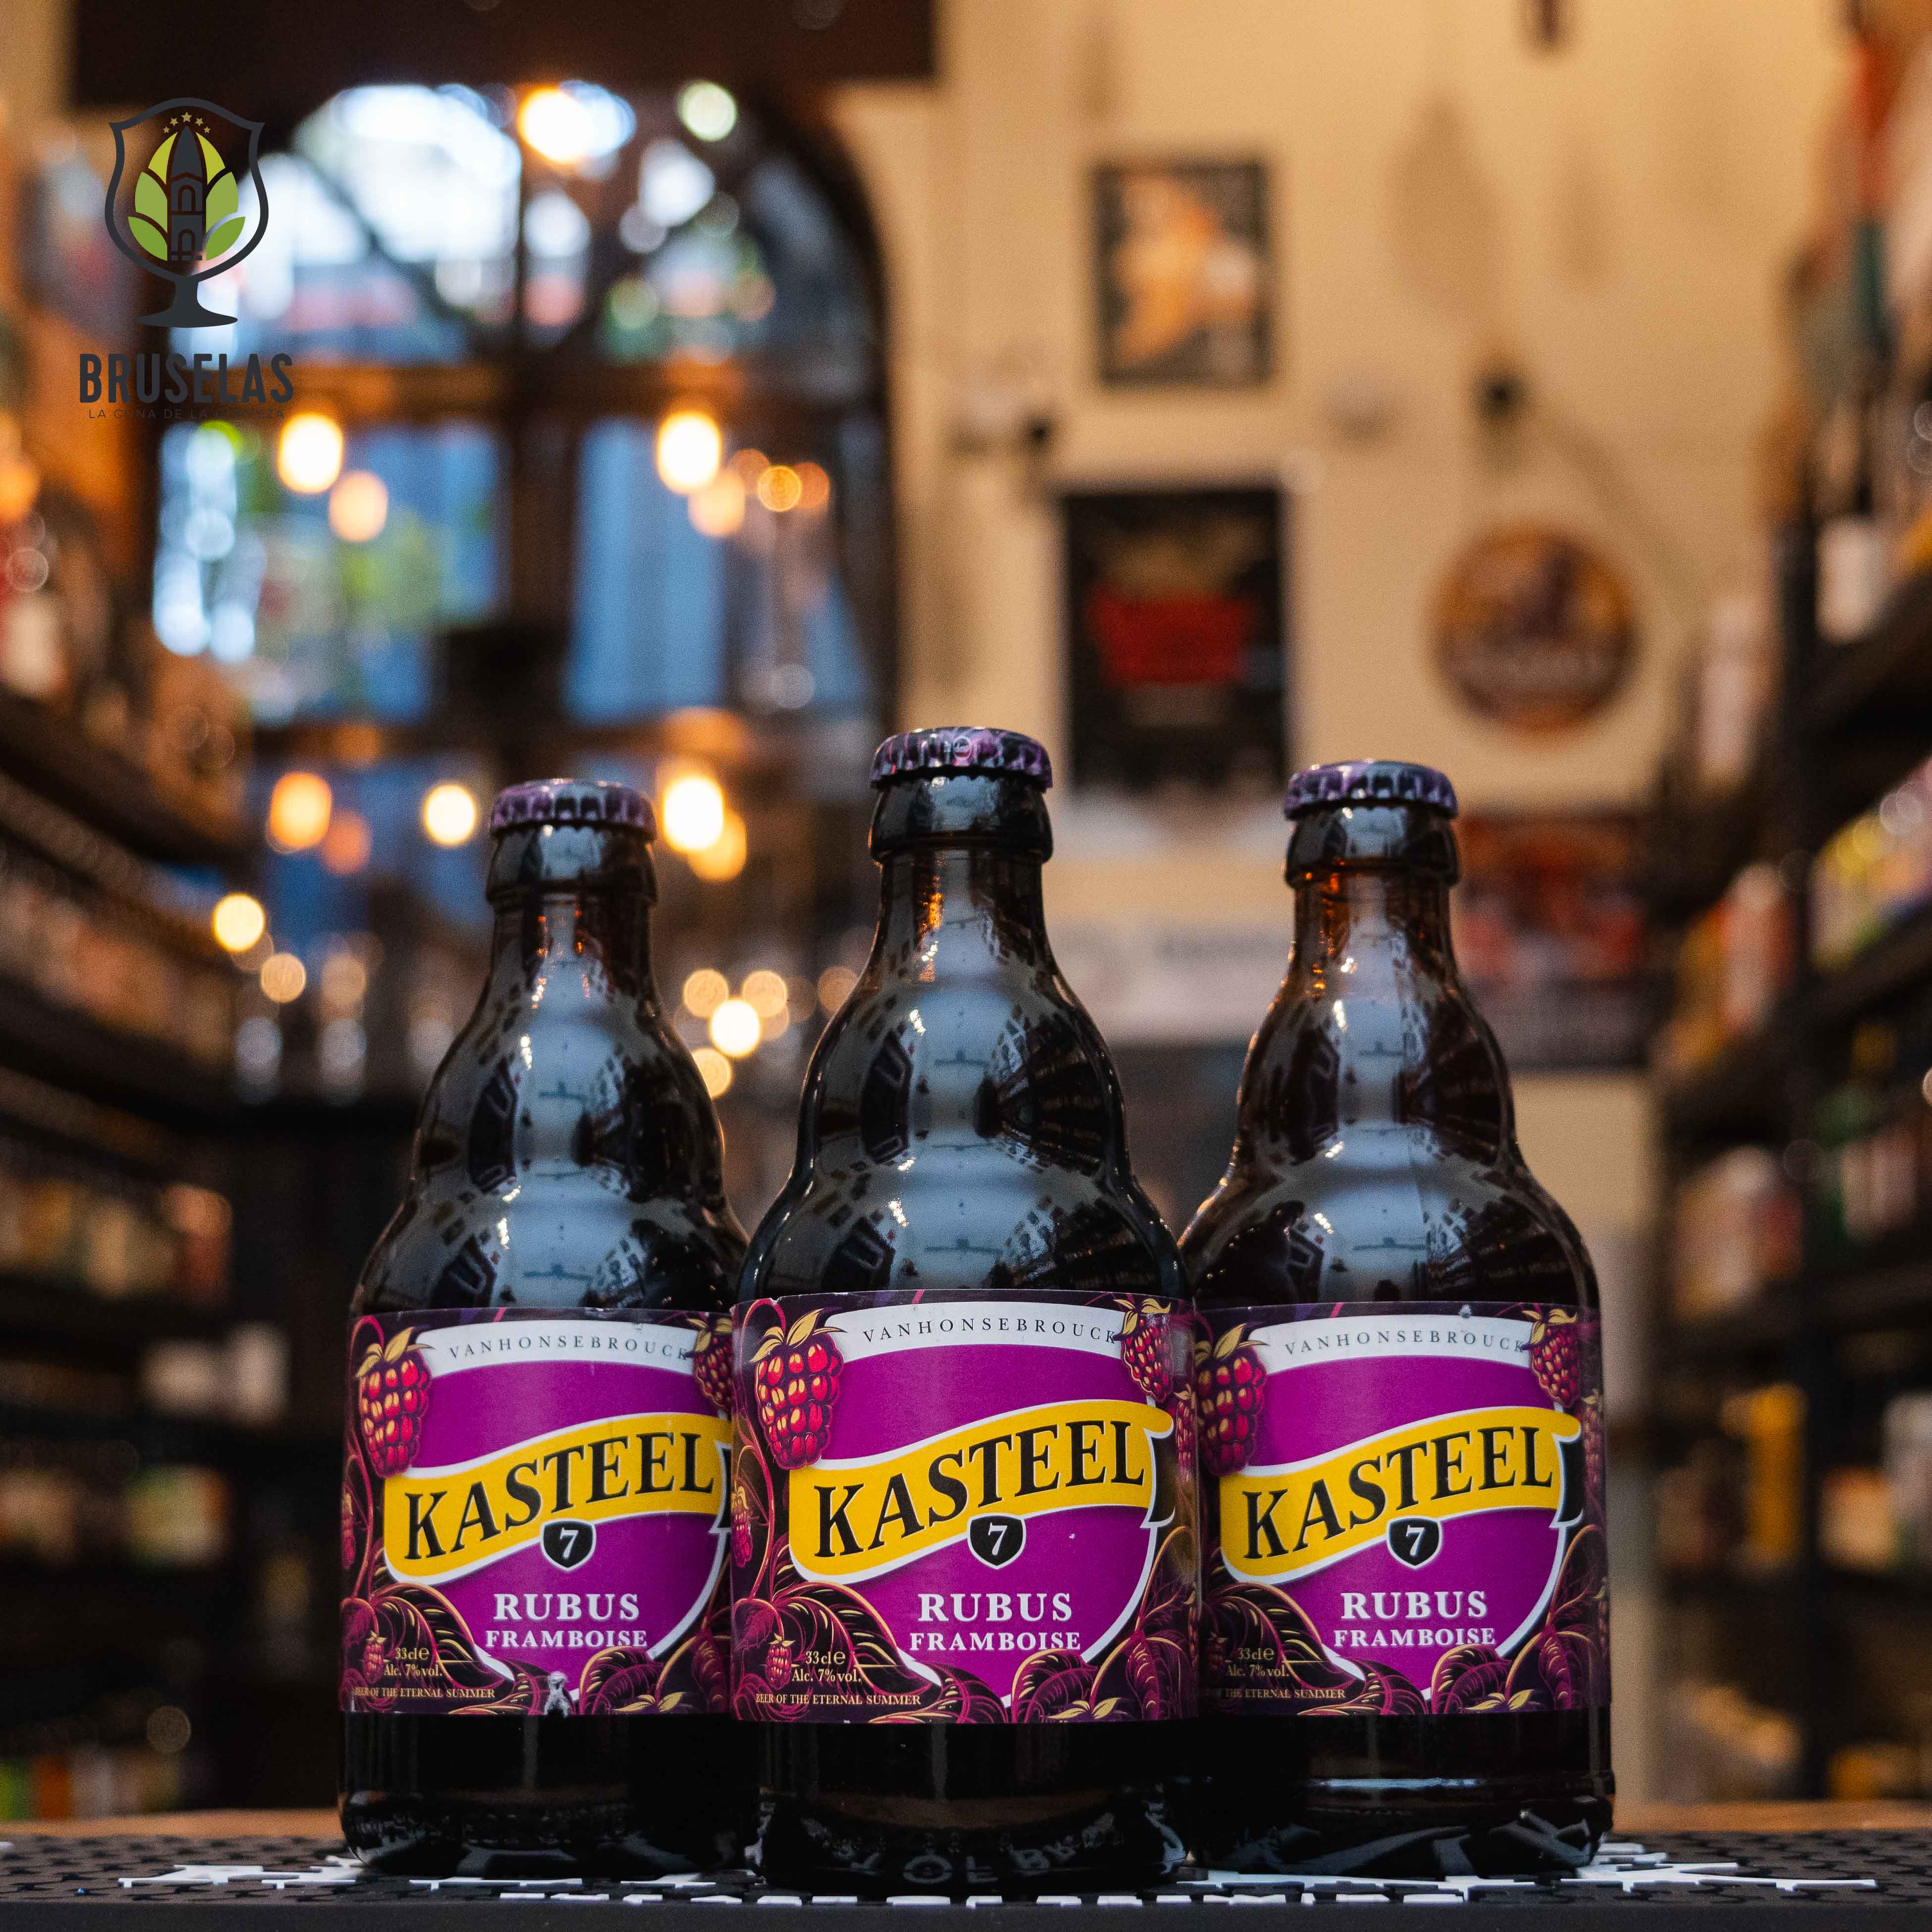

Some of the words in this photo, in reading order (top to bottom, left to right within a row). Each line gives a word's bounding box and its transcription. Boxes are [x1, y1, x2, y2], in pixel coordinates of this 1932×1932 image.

[863, 1317, 1116, 1344] VANHONSEBROUCK
[1285, 1330, 1524, 1355] VANHONSEBROUCK
[449, 1335, 687, 1361] VANHONSEBROUCK
[404, 1432, 714, 1561] KASTEEL
[813, 1420, 1145, 1559] KASTEEL
[1242, 1426, 1553, 1560] KASTEEL
[559, 1529, 578, 1561] 7
[987, 1523, 1008, 1557] 7
[1405, 1526, 1426, 1557] 7
[494, 1593, 640, 1621] RUBUS
[918, 1592, 1072, 1622] RUBUS
[1340, 1590, 1486, 1620] RUBUS
[485, 1630, 647, 1648] FRAMBOISE
[910, 1632, 1081, 1651] FRAMBOISE
[1334, 1628, 1495, 1647] FRAMBOISE
[384, 1664, 402, 1676] Alc.
[792, 1669, 814, 1682] Alc.
[352, 1687, 368, 1696] EER
[382, 1687, 397, 1697] THE
[400, 1687, 444, 1698] ETERNAL
[446, 1688, 495, 1698] SUMMER
[756, 1693, 774, 1703] BEER
[776, 1693, 787, 1703] OF
[790, 1694, 810, 1704] THE
[813, 1694, 863, 1705] ETERNAL
[866, 1694, 922, 1705] SUMMER
[1225, 1688, 1242, 1698] THE
[1245, 1688, 1291, 1698] ETERNAL
[1294, 1688, 1346, 1698] SUMMER
